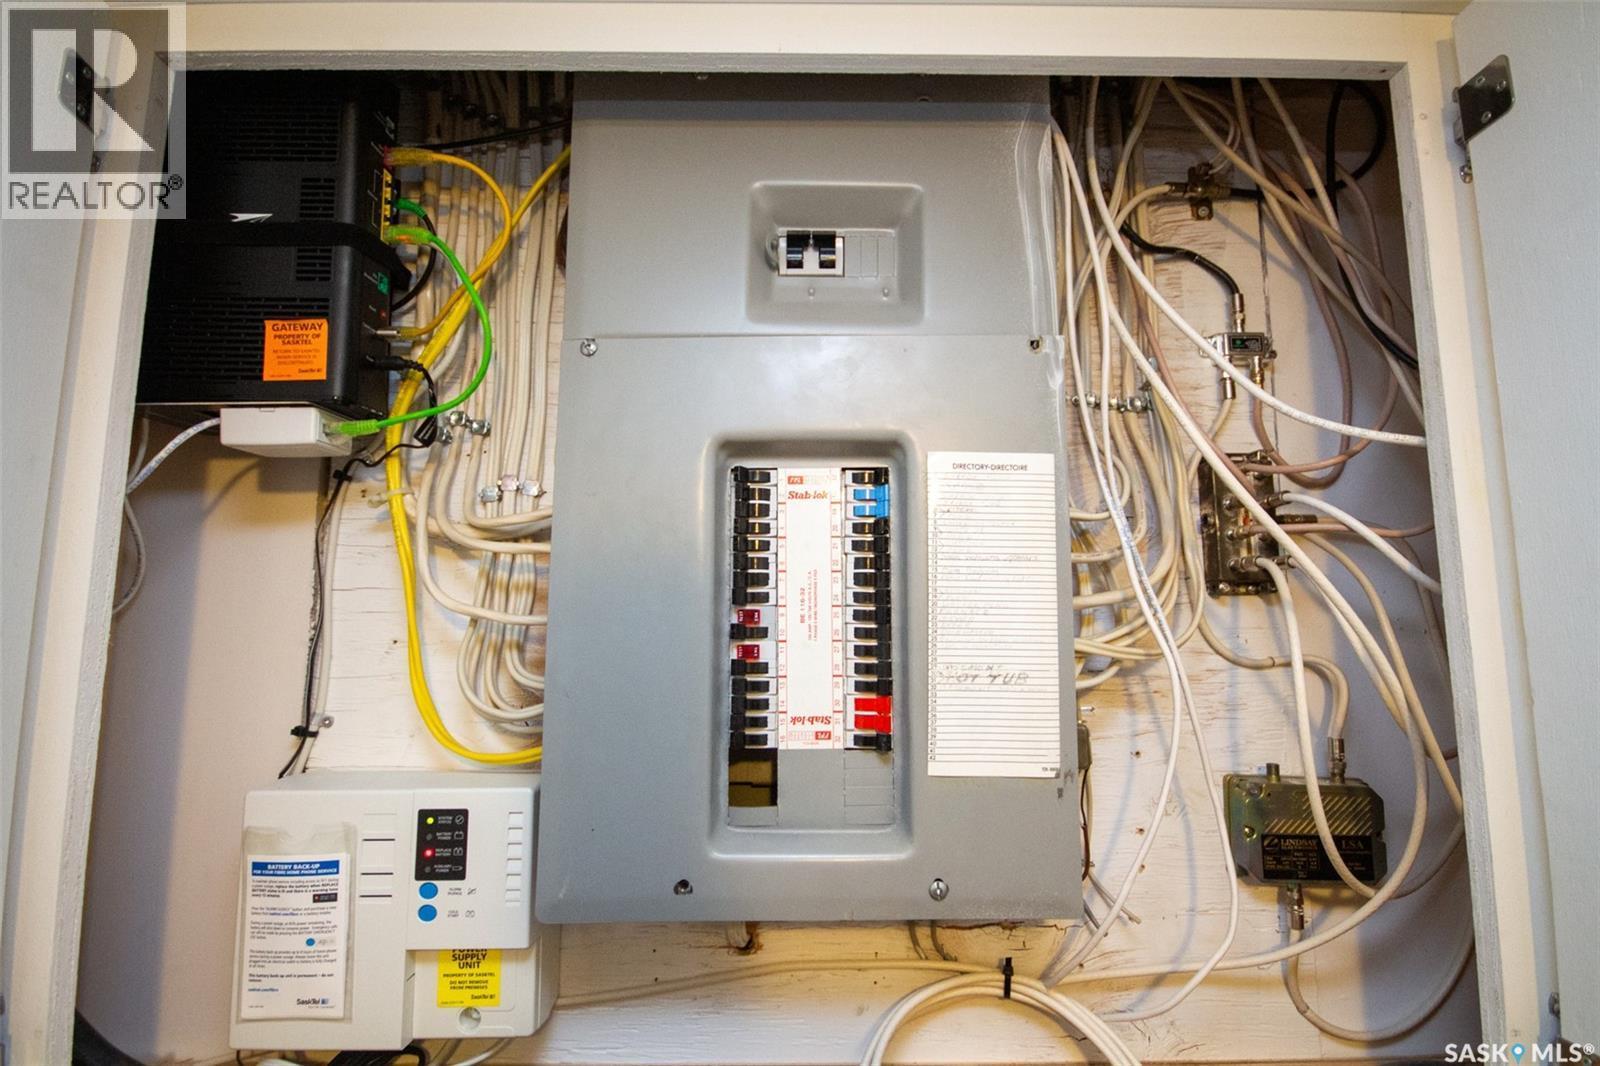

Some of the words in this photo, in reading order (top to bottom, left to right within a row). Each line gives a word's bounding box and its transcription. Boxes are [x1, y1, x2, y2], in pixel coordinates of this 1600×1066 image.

[272, 322, 323, 332] GATEWAY
[952, 462, 1028, 471] DIRECTORY-DIRECTOIRE
[452, 953, 487, 961] SUPPLY
[458, 961, 481, 969] UNIT
